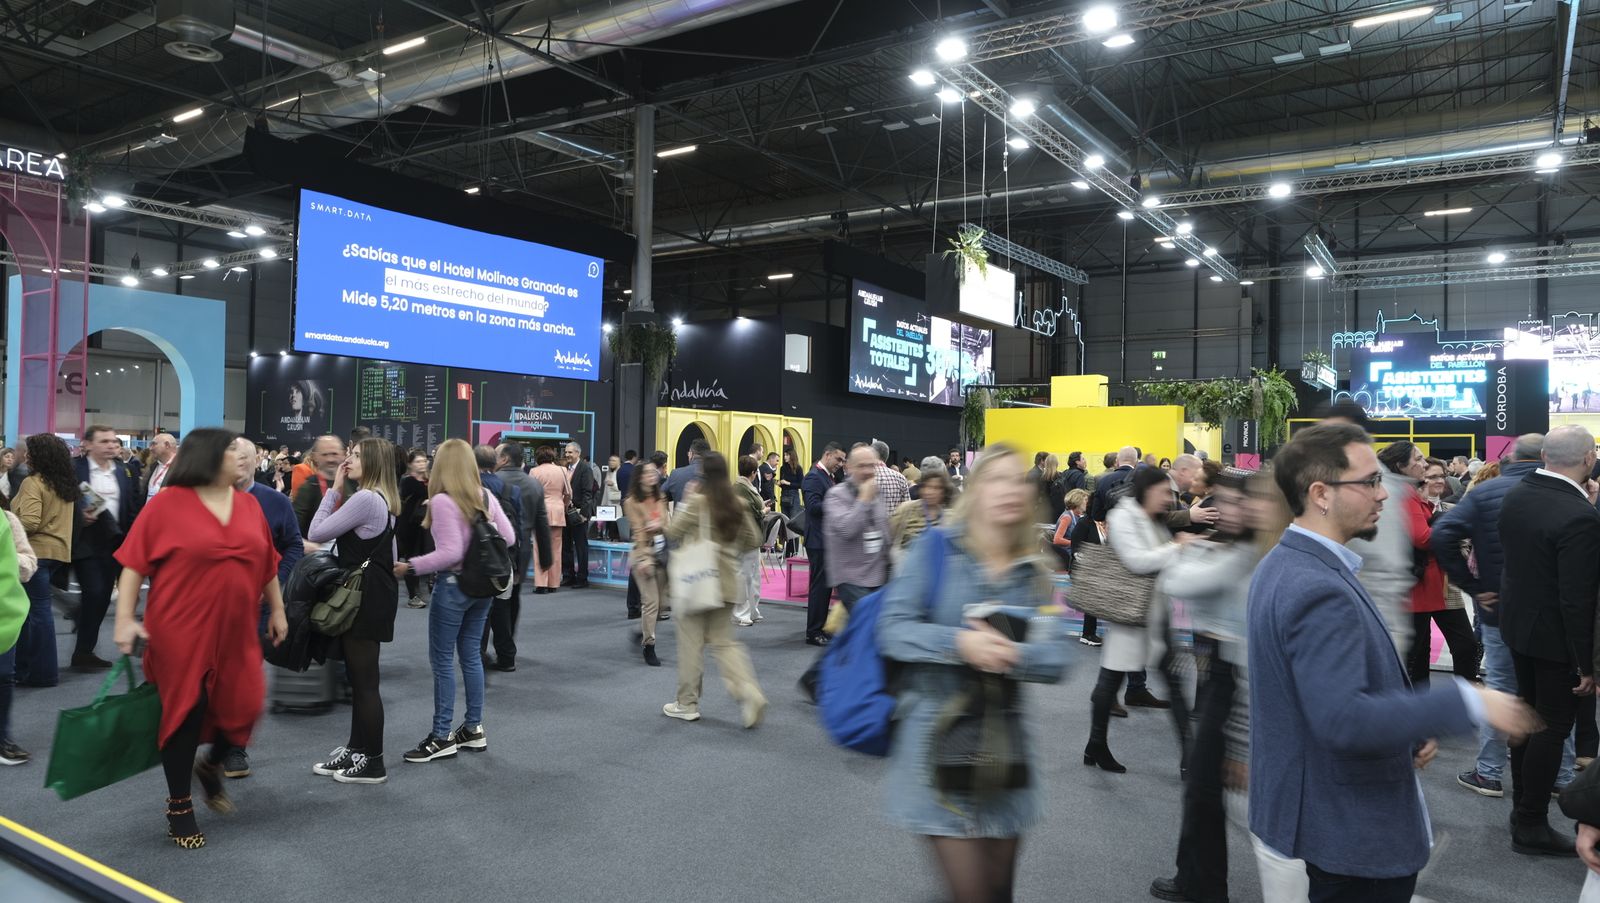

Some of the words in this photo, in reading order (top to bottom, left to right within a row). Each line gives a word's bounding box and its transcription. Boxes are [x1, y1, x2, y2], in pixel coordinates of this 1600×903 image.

[0, 148, 64, 180] REA
[342, 243, 399, 265] ¿Sabías
[401, 255, 427, 271] que
[429, 259, 441, 273] el
[443, 261, 474, 279] Hotel
[477, 267, 519, 287] Molinos
[521, 277, 565, 296] Granada
[567, 287, 579, 298] es
[385, 275, 397, 286] el
[400, 278, 429, 293] más
[432, 283, 484, 300] estrecho
[486, 291, 504, 304] del
[506, 296, 550, 312] mundo?
[342, 289, 378, 307] Mide
[380, 295, 409, 312] 5,20
[411, 301, 456, 319] metros
[458, 310, 473, 322] en
[476, 310, 487, 323] la
[489, 314, 516, 328] zona
[518, 317, 541, 332] más
[543, 323, 576, 337] ancha.
[870, 333, 924, 358] ASISTENTES
[870, 350, 909, 371] TOTALES
[1430, 361, 1445, 369] DEL
[1382, 369, 1488, 384] ASISTENTES
[660, 379, 729, 401] Andalucía
[1382, 384, 1457, 398] TOTALES
[1496, 366, 1507, 431] CÓRDOBA
